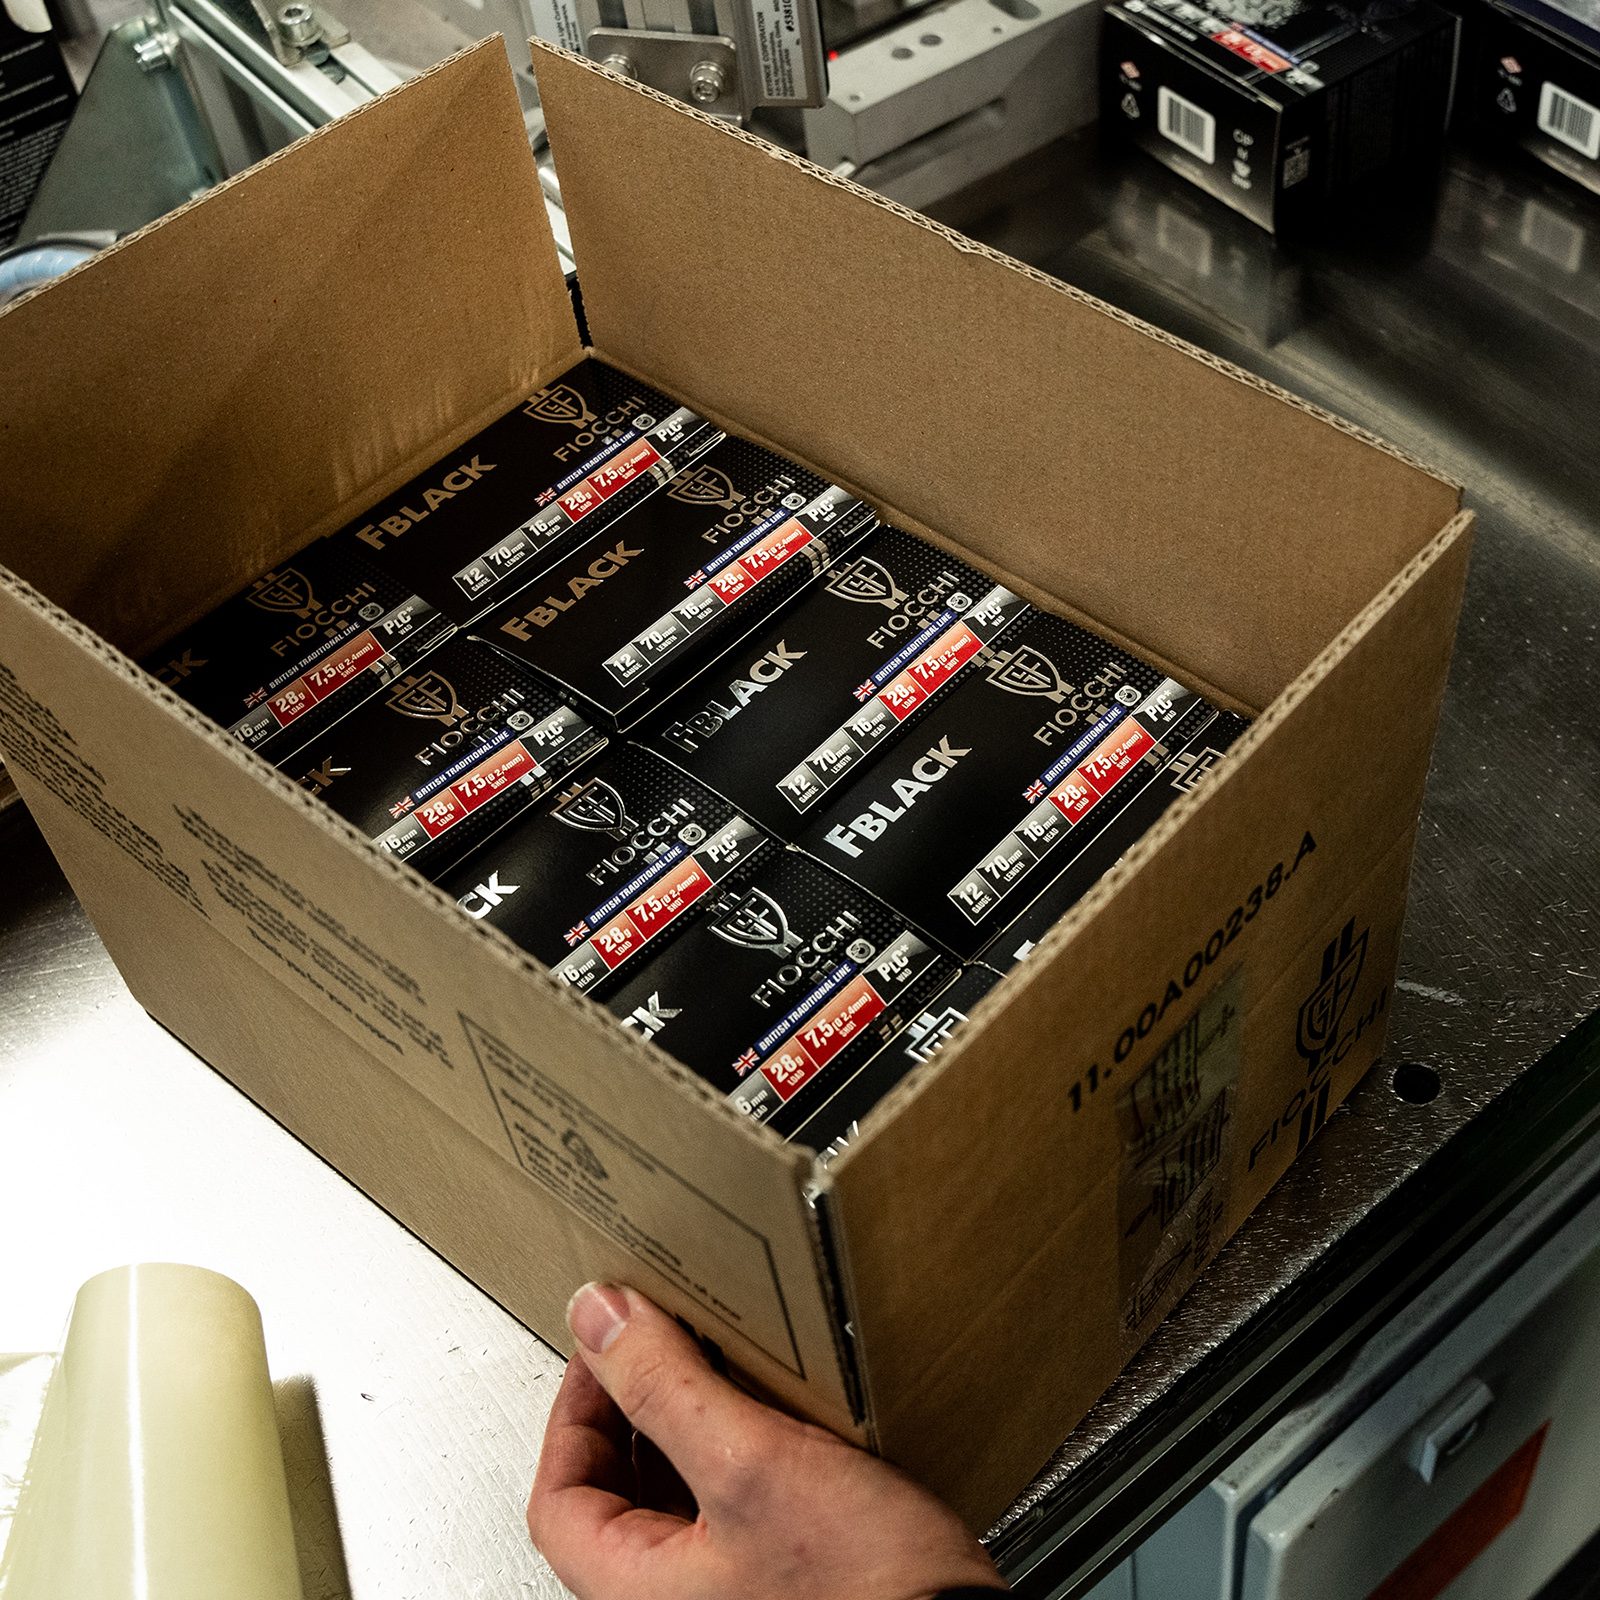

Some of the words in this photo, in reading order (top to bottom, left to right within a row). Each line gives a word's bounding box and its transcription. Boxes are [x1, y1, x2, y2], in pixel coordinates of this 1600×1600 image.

[553, 395, 646, 462] FIOCCHI
[672, 430, 686, 442] WAD
[555, 467, 583, 489] BRITISH
[580, 439, 622, 471] TRADITIONAL
[618, 429, 636, 443] LINE
[622, 466, 637, 479] SHOT
[355, 454, 497, 550] FBLACK
[578, 499, 593, 512] LOAD
[701, 474, 797, 545] FIOCCHI
[824, 511, 838, 522] WAD
[545, 523, 561, 537] HEAD
[705, 548, 733, 570] BRITISH
[730, 519, 772, 552] TRADITIONAL
[769, 509, 786, 523] LINE
[504, 550, 526, 567] LENGTH
[774, 548, 790, 561] SHOT
[461, 565, 485, 585] 12
[471, 575, 491, 592] GAUGE
[500, 540, 644, 642] FBLACK
[730, 581, 746, 595] LOAD
[270, 582, 377, 657] FIOCCHI
[697, 606, 714, 620] HEAD
[866, 571, 959, 650] FIOCCHI
[398, 623, 413, 635] WAD
[992, 614, 1006, 627] WAD
[656, 634, 678, 652] LENGTH
[873, 656, 901, 681] BRITISH
[897, 623, 939, 660] TRADITIONAL
[934, 611, 952, 628] LINE
[267, 664, 299, 689] BRITISH
[297, 632, 344, 668] TRADITIONAL
[341, 621, 360, 637] LINE
[611, 651, 636, 671] 12
[944, 656, 960, 671] SHOT
[341, 663, 358, 678] SHOT
[622, 661, 643, 678] GAUGE
[661, 639, 808, 754] FBLACK
[901, 694, 918, 710] LOAD
[1033, 661, 1128, 747] FIOCCHI
[288, 700, 306, 716] LOAD
[1162, 708, 1177, 723] WAD
[415, 688, 524, 766] FIOCCHI
[870, 722, 887, 738] HEAD
[249, 728, 268, 745] HEAD
[550, 735, 565, 748] WAD
[1043, 754, 1072, 782] BRITISH
[1067, 718, 1109, 759] TRADITIONAL
[1104, 706, 1122, 724] LINE
[413, 772, 447, 798] BRITISH
[444, 741, 494, 778] TRADITIONAL
[490, 730, 510, 747] LINE
[830, 753, 852, 774] LENGTH
[1115, 754, 1131, 770] SHOT
[491, 775, 508, 790] SHOT
[786, 772, 811, 795] 12
[798, 784, 819, 803] GAUGE
[823, 735, 972, 858] FBLACK
[1073, 795, 1090, 812] LOAD
[437, 811, 456, 827] LOAD
[586, 798, 695, 886] FIOCCHI
[1042, 826, 1059, 843] HEAD
[397, 839, 416, 855] HEAD
[725, 849, 740, 864] WAD
[1003, 860, 1025, 883] LENGTH
[588, 893, 621, 923] BRITISH
[618, 857, 666, 899] TRADITIONAL
[662, 845, 682, 863] LINE
[957, 880, 984, 906] 12
[667, 895, 685, 912] SHOT
[971, 893, 992, 915] GAUGE
[615, 938, 634, 956] LOAD
[751, 910, 861, 1008] FIOCCHI
[896, 967, 911, 984] WAD
[1067, 829, 1318, 1113] 11.00A00238.A
[576, 971, 595, 990] HEAD
[757, 1017, 791, 1050] BRITISH
[787, 977, 836, 1023] TRADITIONAL
[831, 963, 852, 984] LINE
[839, 1018, 858, 1037] SHOT
[787, 1066, 807, 1086] LOAD
